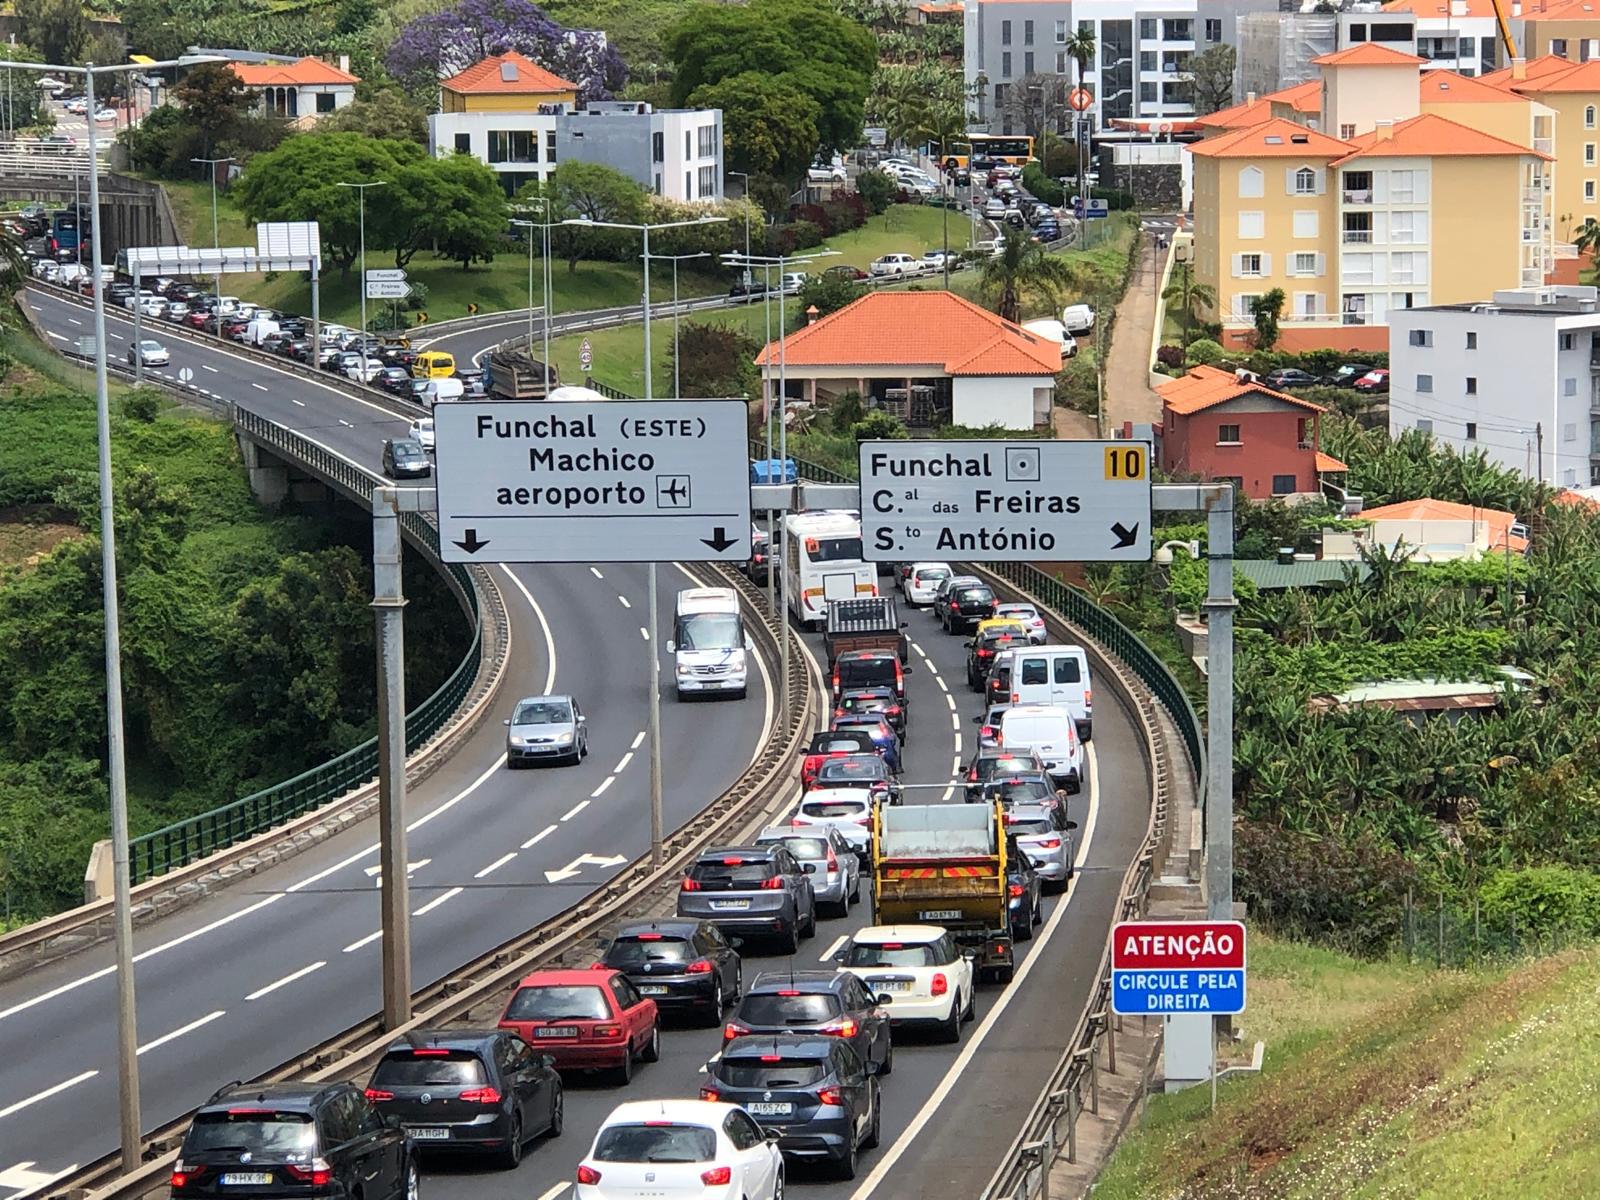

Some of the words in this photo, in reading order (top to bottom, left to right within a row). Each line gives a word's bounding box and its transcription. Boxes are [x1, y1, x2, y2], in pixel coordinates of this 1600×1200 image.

[477, 414, 597, 438] Funchal
[620, 417, 706, 438] (ESTE)
[529, 447, 655, 471] Machico
[871, 453, 992, 477] Funchal
[1109, 450, 1140, 478] 10
[496, 481, 646, 509] aeroporto
[932, 501, 959, 514] das
[975, 489, 1081, 514] Freiras
[936, 526, 1056, 551] António
[1123, 930, 1234, 961] ATENÇÃO
[1119, 974, 1189, 990] CIRCULE
[1198, 973, 1238, 989] PELA
[1147, 994, 1210, 1010] DIREITA
